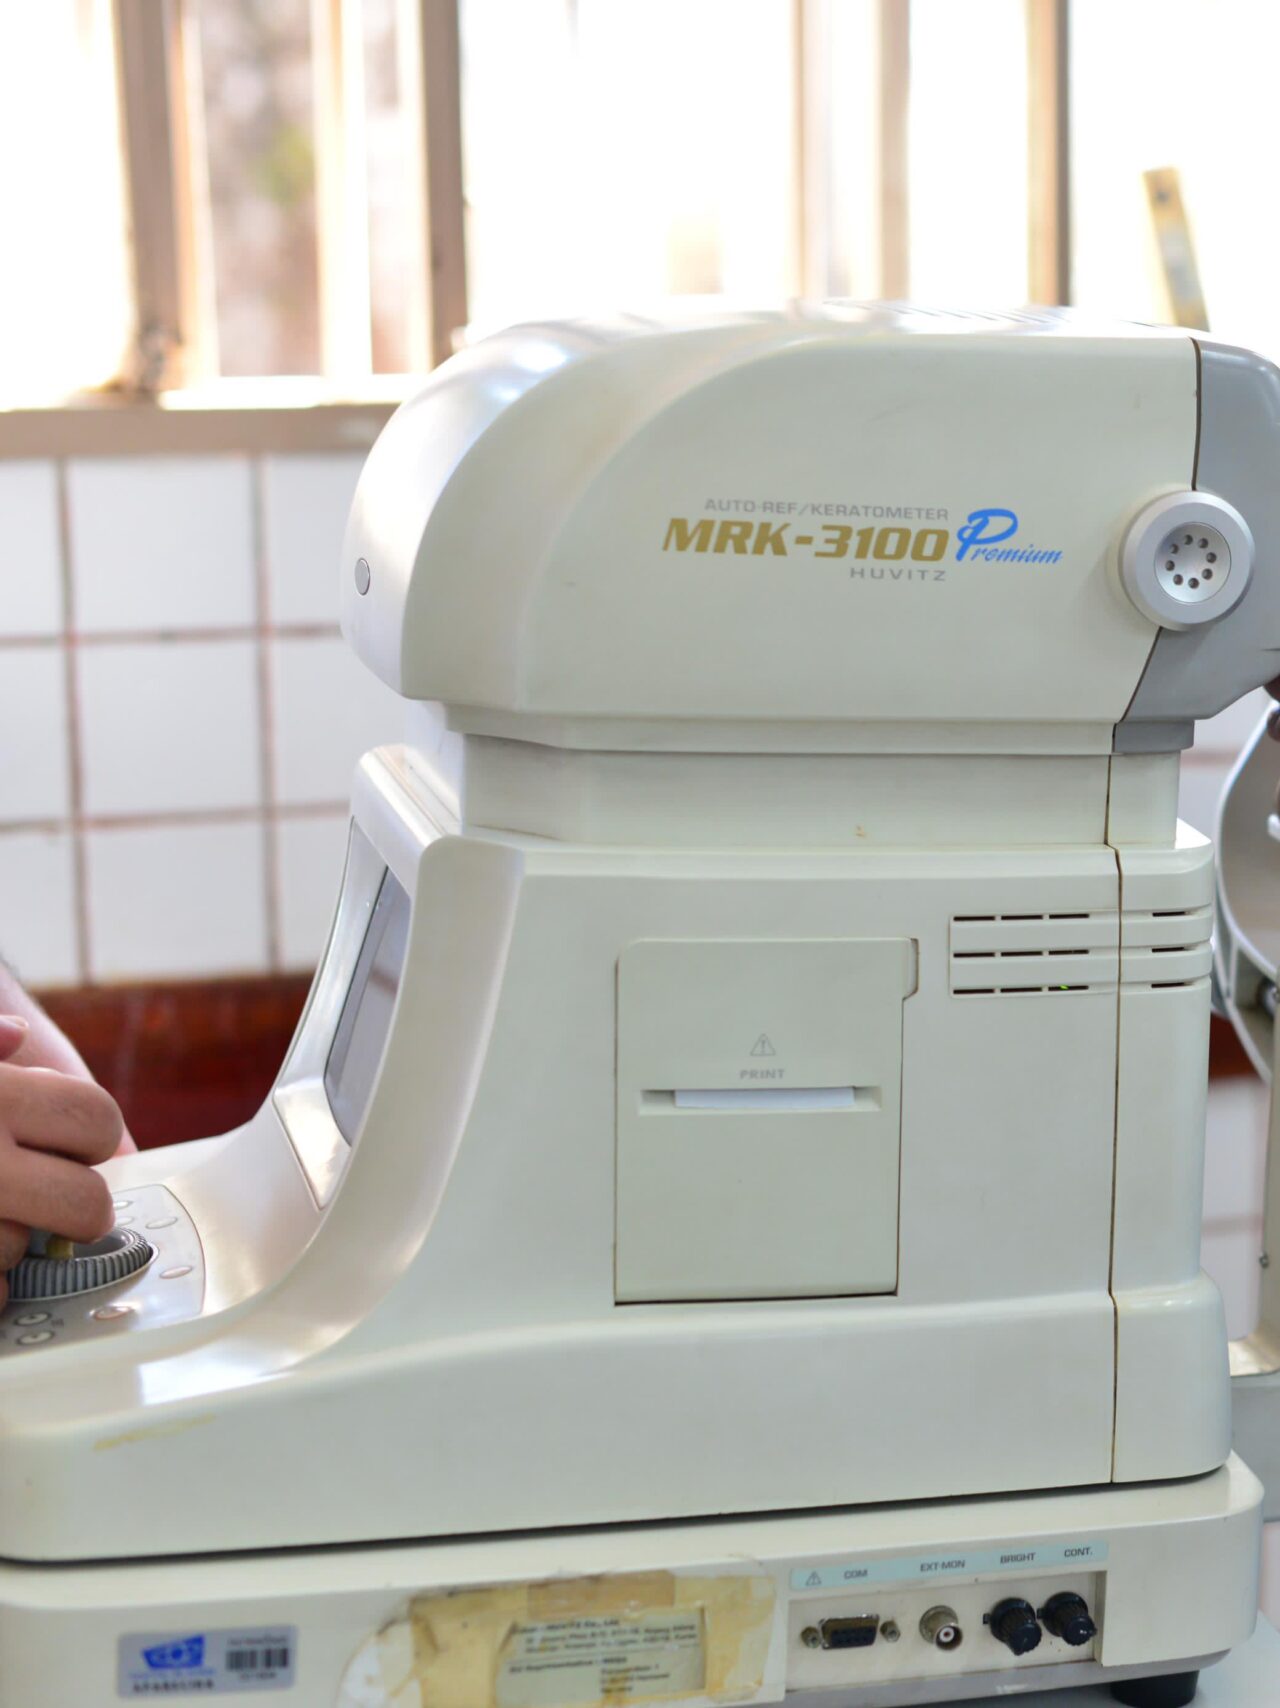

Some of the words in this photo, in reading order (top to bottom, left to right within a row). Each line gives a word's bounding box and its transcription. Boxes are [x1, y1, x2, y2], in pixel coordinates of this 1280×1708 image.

[661, 517, 950, 562] MRK-3100
[955, 508, 1063, 564] Premium
[849, 566, 947, 582] HUVITZ
[739, 1068, 786, 1081] PRINT
[843, 1568, 869, 1581] COM
[1000, 1552, 1037, 1565] BRIGHT
